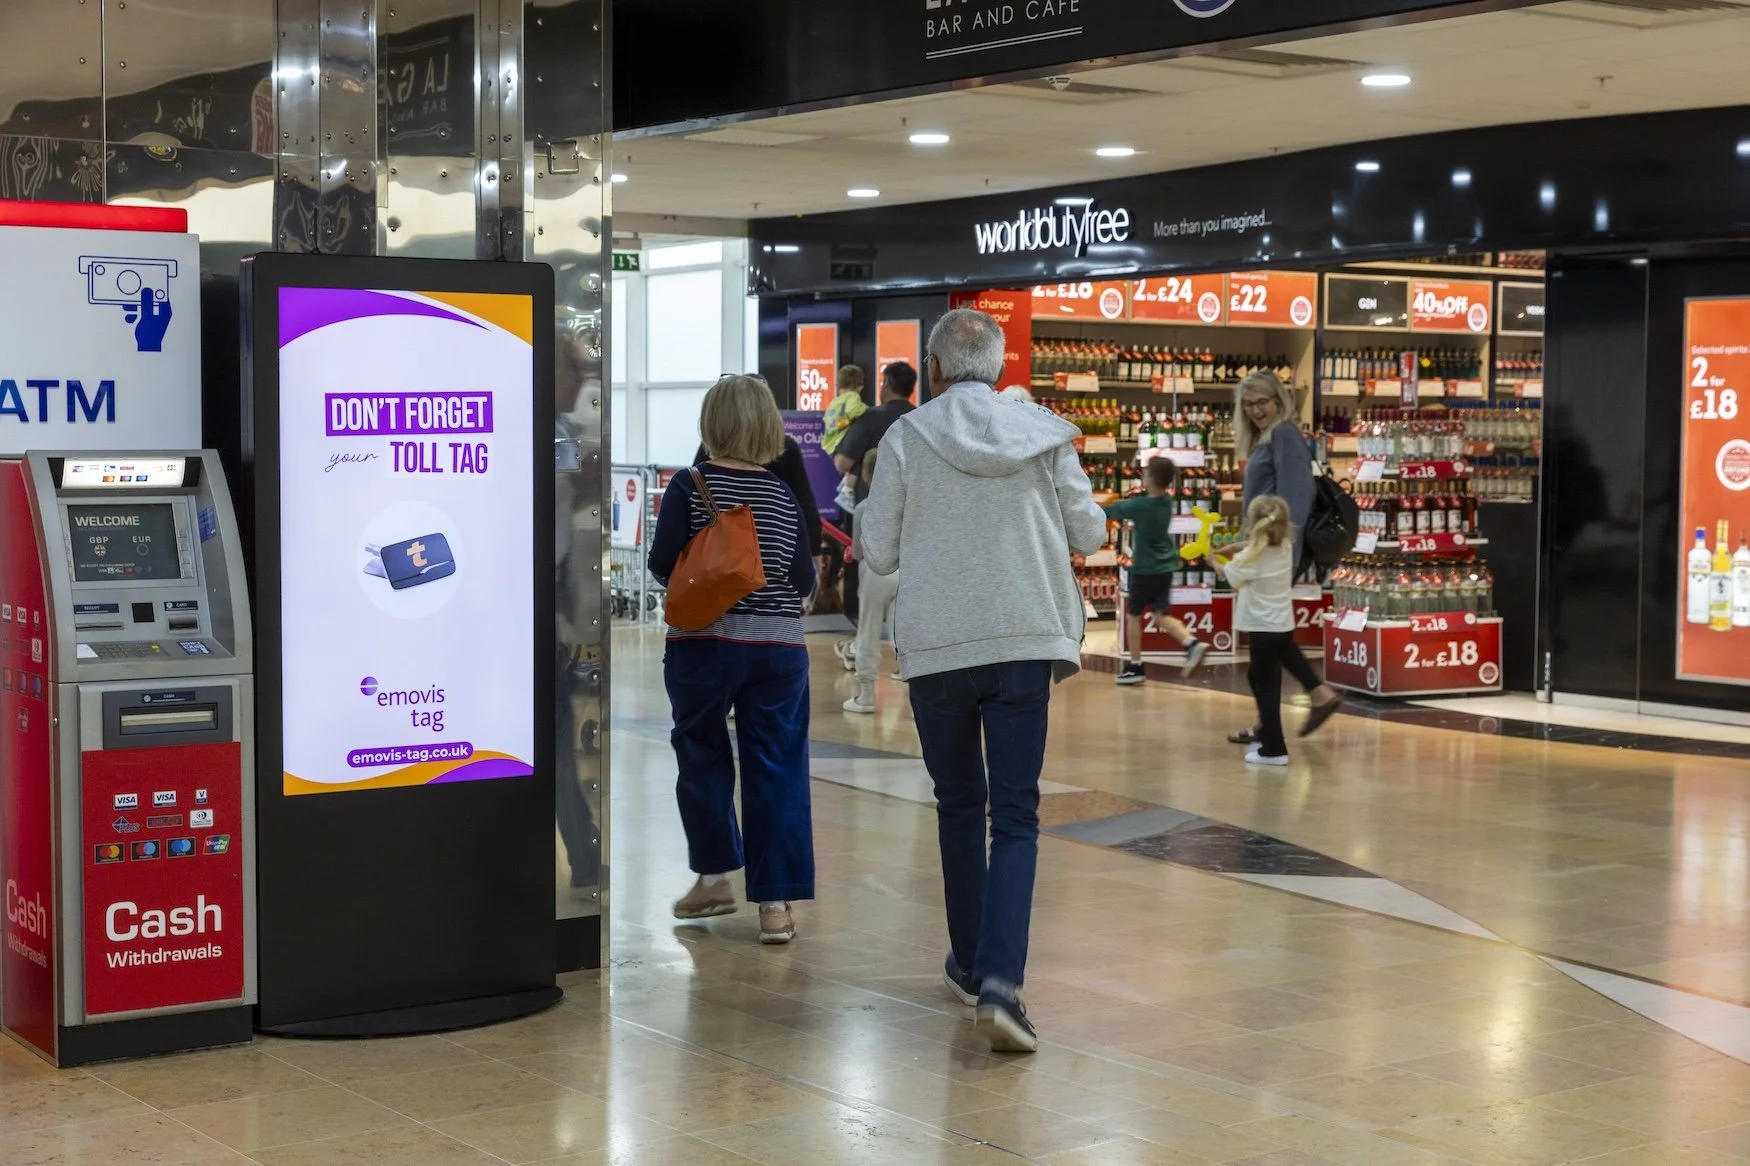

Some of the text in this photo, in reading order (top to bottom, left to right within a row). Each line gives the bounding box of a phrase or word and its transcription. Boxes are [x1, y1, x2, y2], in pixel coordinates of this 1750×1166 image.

[926, 14, 962, 38] BAR
[972, 5, 1014, 30] AND
[1153, 209, 1273, 238] More than you imagined...
[1133, 278, 1146, 301] 2
[1157, 277, 1194, 304] £24
[1230, 284, 1268, 313] £22
[978, 298, 1014, 310] chance
[1691, 345, 1724, 354] Selected
[800, 368, 829, 391] 50%
[1690, 356, 1726, 387] 2 for
[0, 379, 116, 424] ATM
[331, 396, 488, 431] DON'T FORGET
[800, 392, 823, 411] Off
[1689, 388, 1739, 420] £18
[324, 441, 489, 474] your TOLL TAG
[1400, 466, 1410, 479] 2
[75, 515, 140, 527] WELCOME
[89, 536, 109, 544] GBP
[132, 535, 152, 543] EUR
[1400, 539, 1410, 552] 2
[1411, 619, 1421, 632] 2
[1333, 637, 1341, 662] 2
[1347, 640, 1368, 668] £18
[1403, 639, 1479, 669] 2 for £18
[377, 684, 445, 706] emovis
[410, 709, 445, 732] tag
[352, 744, 469, 764] emovis-tag.co.uk
[117, 796, 136, 804] VISA
[156, 792, 175, 801] VISA
[6, 878, 47, 939] Cash
[106, 894, 223, 942] Cash
[7, 931, 47, 969] Withdrawals
[106, 942, 223, 969] Withdrawals
